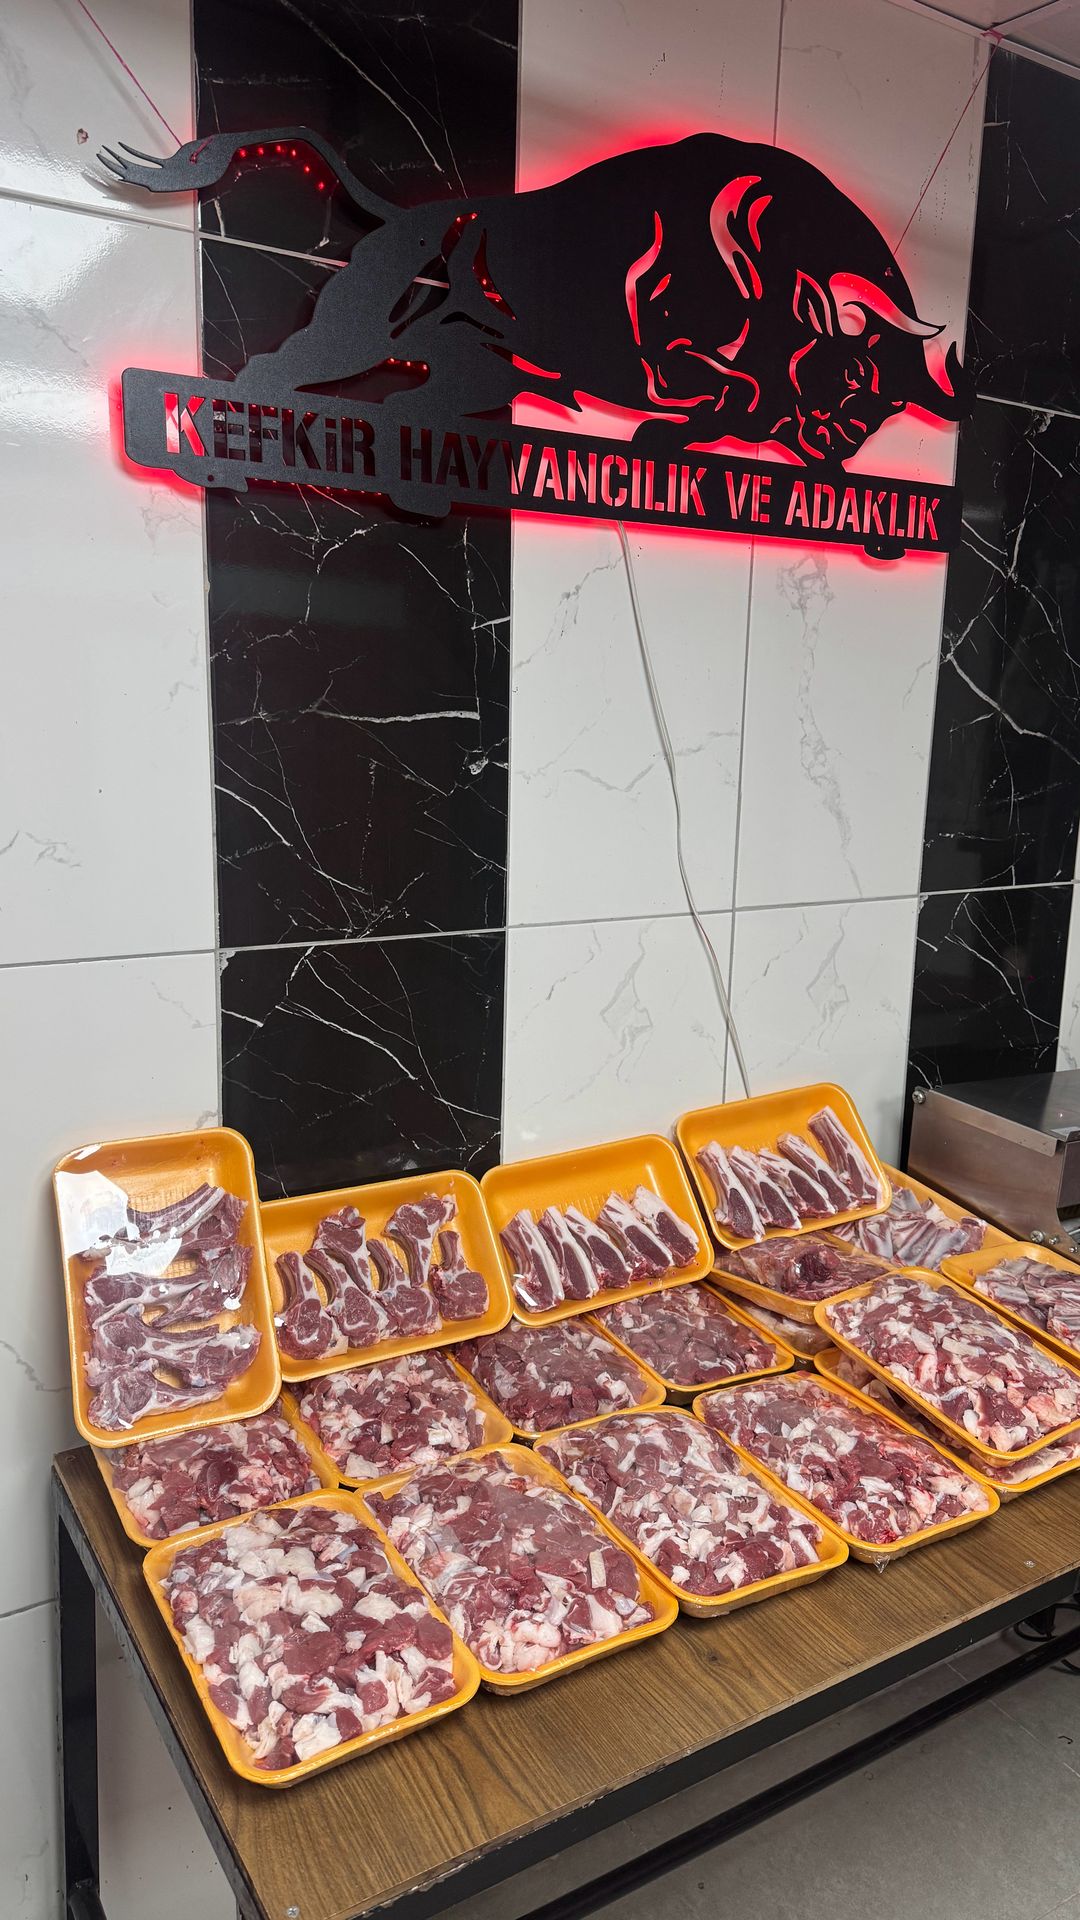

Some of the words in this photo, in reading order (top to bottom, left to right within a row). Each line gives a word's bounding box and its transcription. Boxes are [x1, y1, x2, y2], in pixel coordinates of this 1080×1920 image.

[400, 425, 707, 516] HAYVANCILIK
[724, 471, 773, 523] VE
[785, 480, 940, 541] ADAKLIK
